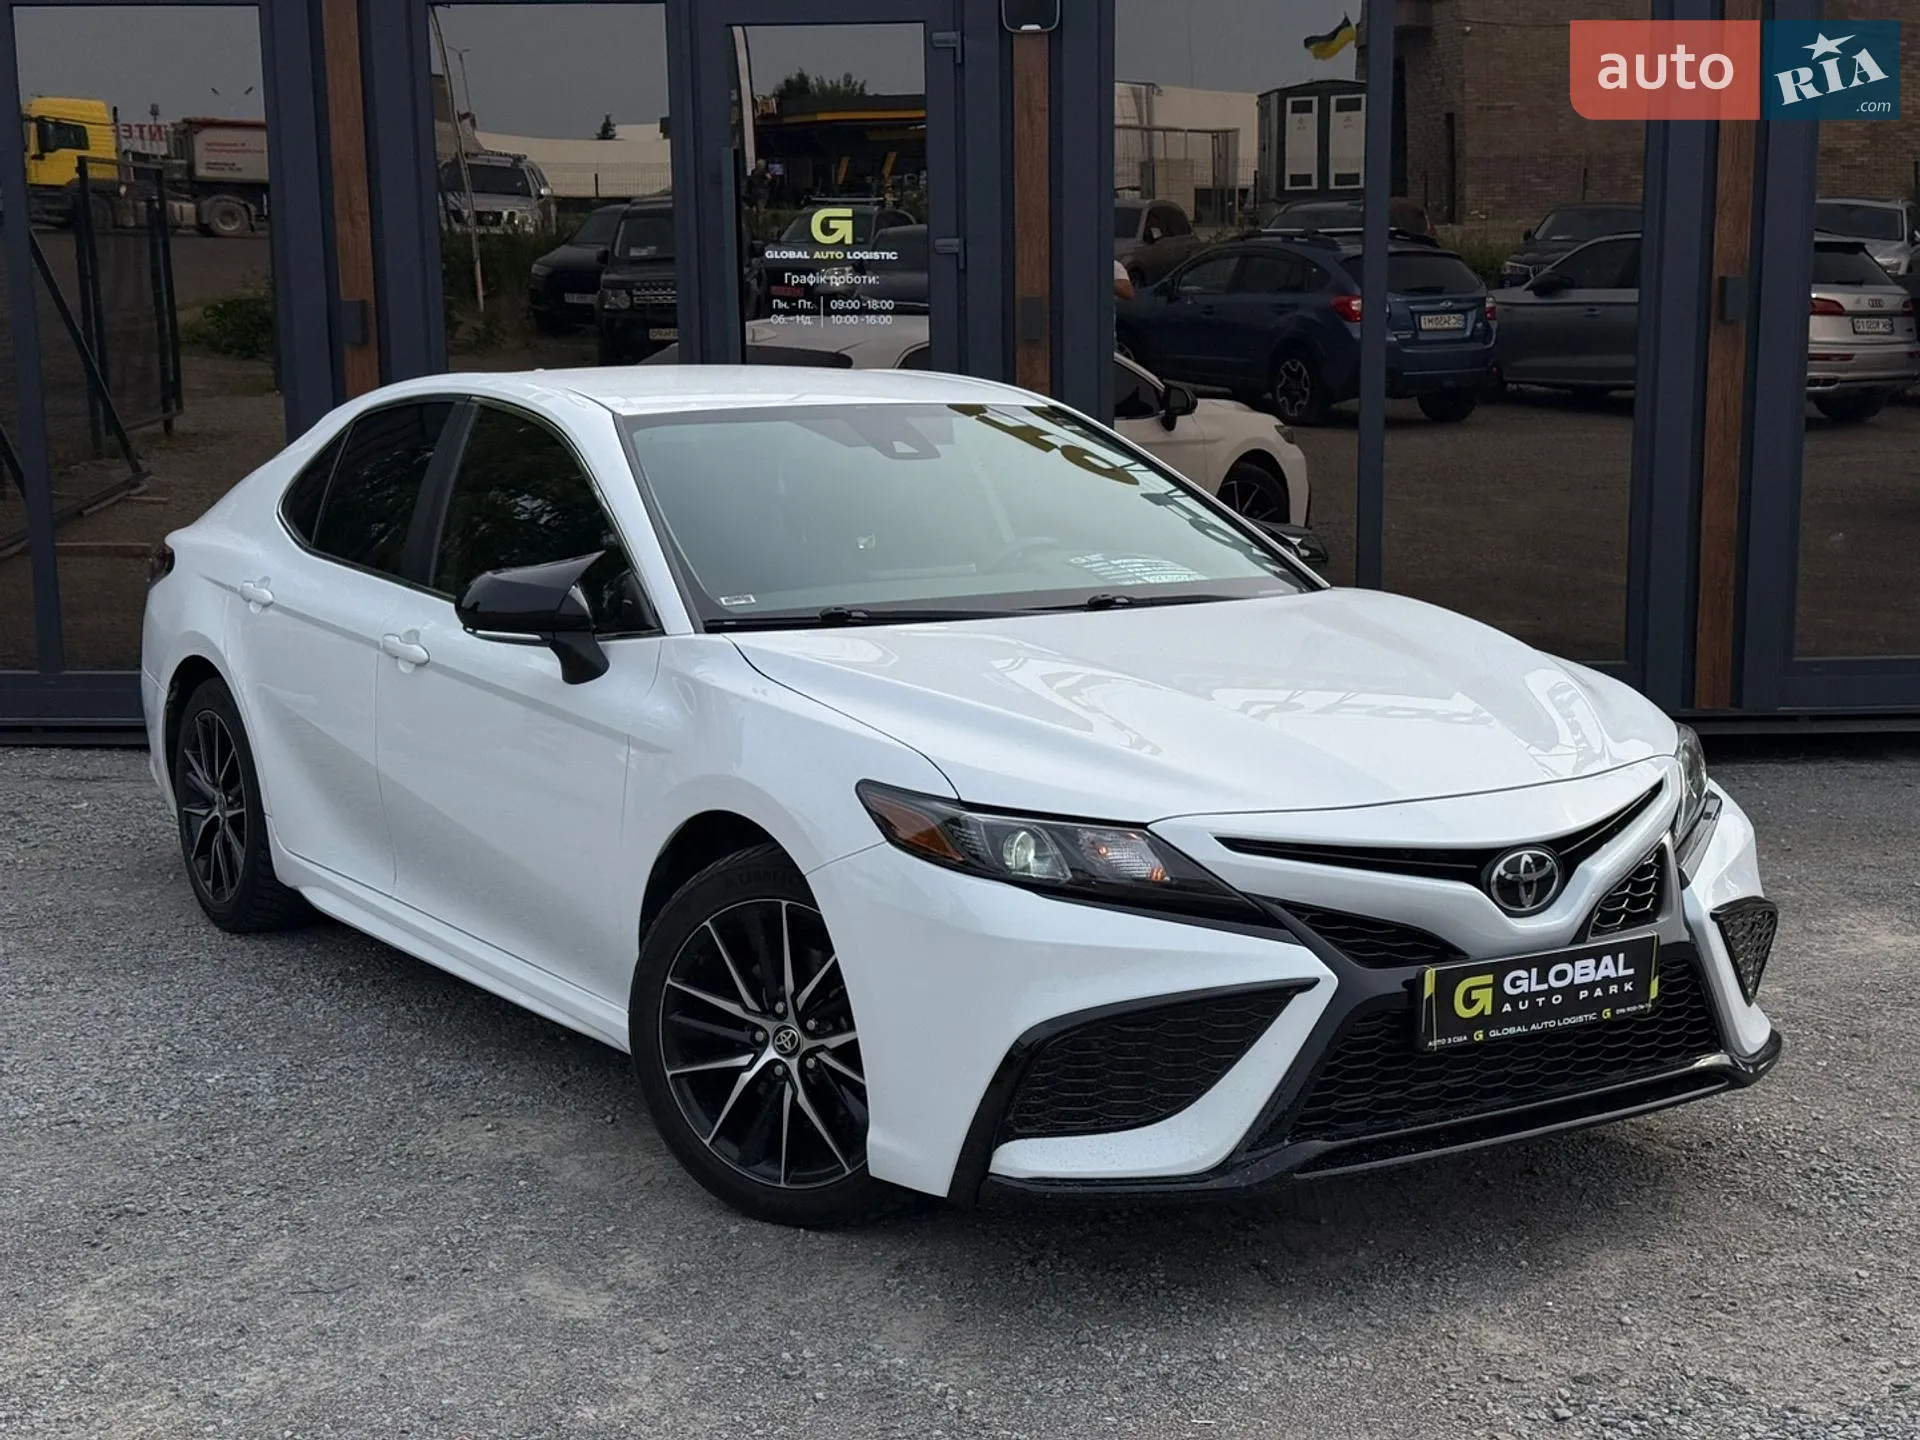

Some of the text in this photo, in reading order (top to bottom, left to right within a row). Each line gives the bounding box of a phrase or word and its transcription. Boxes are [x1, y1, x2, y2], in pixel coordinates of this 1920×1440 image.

[765, 250, 899, 260] GLOBAL AUTO LOGISTIC
[784, 272, 880, 286] Графік роботи:
[772, 300, 789, 310] Пн.
[798, 300, 814, 310] Пт.
[830, 300, 860, 310] 09:00
[770, 315, 788, 325] Сб.
[831, 315, 859, 325] 10:00
[1503, 952, 1635, 996] GLOBAL
[1501, 981, 1635, 1013] AUTO PARK
[1488, 1011, 1598, 1038] GLOBAL AUTO LOGISTIC
